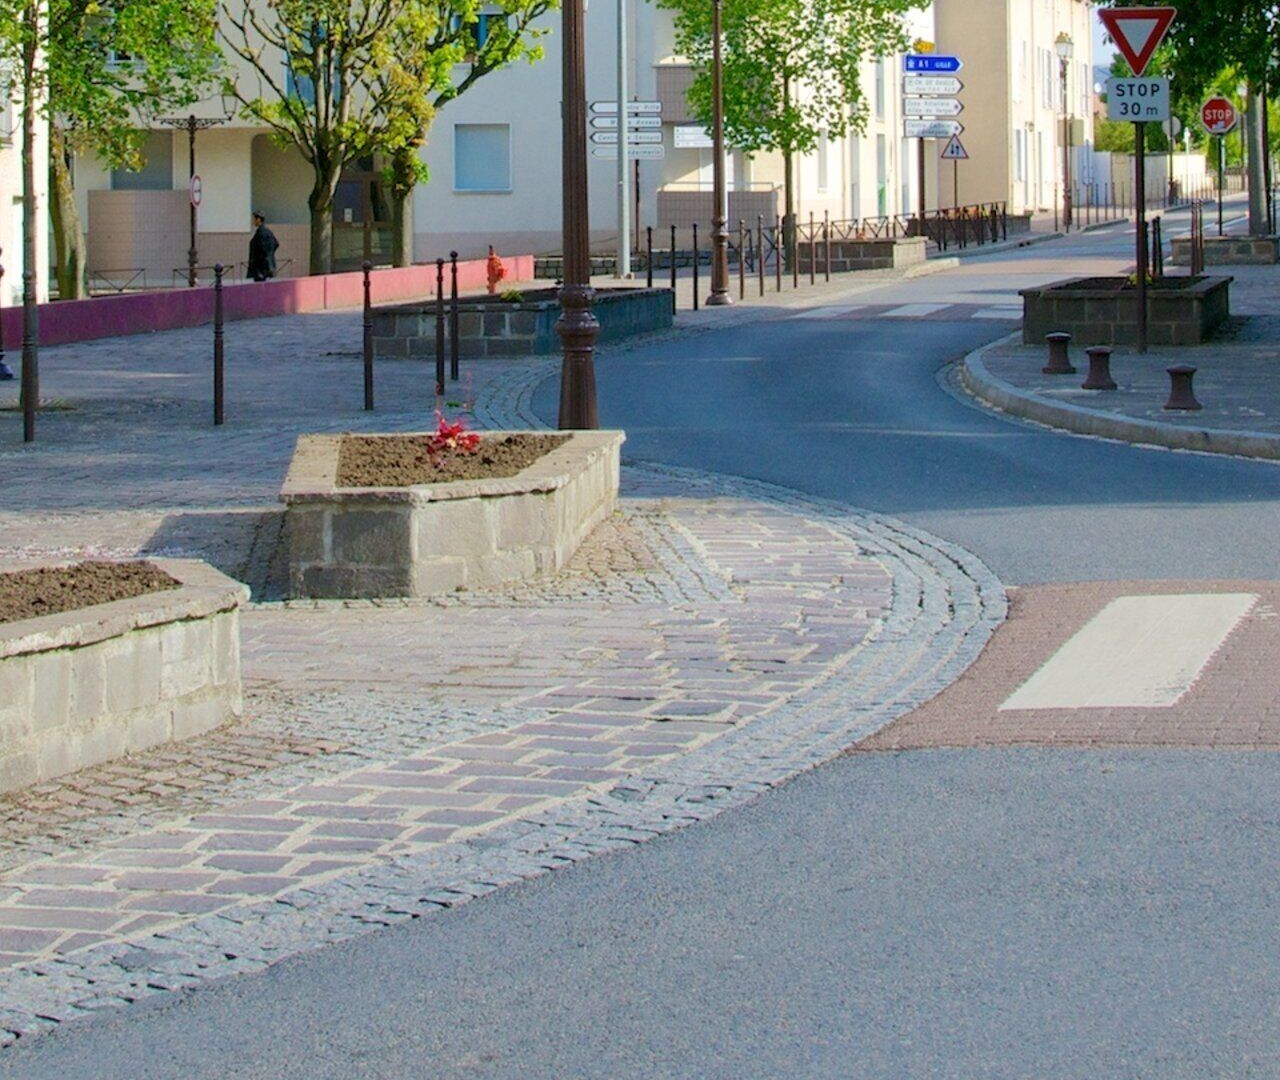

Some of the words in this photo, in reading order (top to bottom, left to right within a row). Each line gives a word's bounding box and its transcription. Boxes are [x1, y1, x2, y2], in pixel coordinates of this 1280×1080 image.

[918, 59, 929, 68] A1
[1115, 82, 1161, 98] STOP
[1119, 102, 1142, 117] 30
[1146, 106, 1158, 117] m
[1204, 108, 1232, 121] STOP
